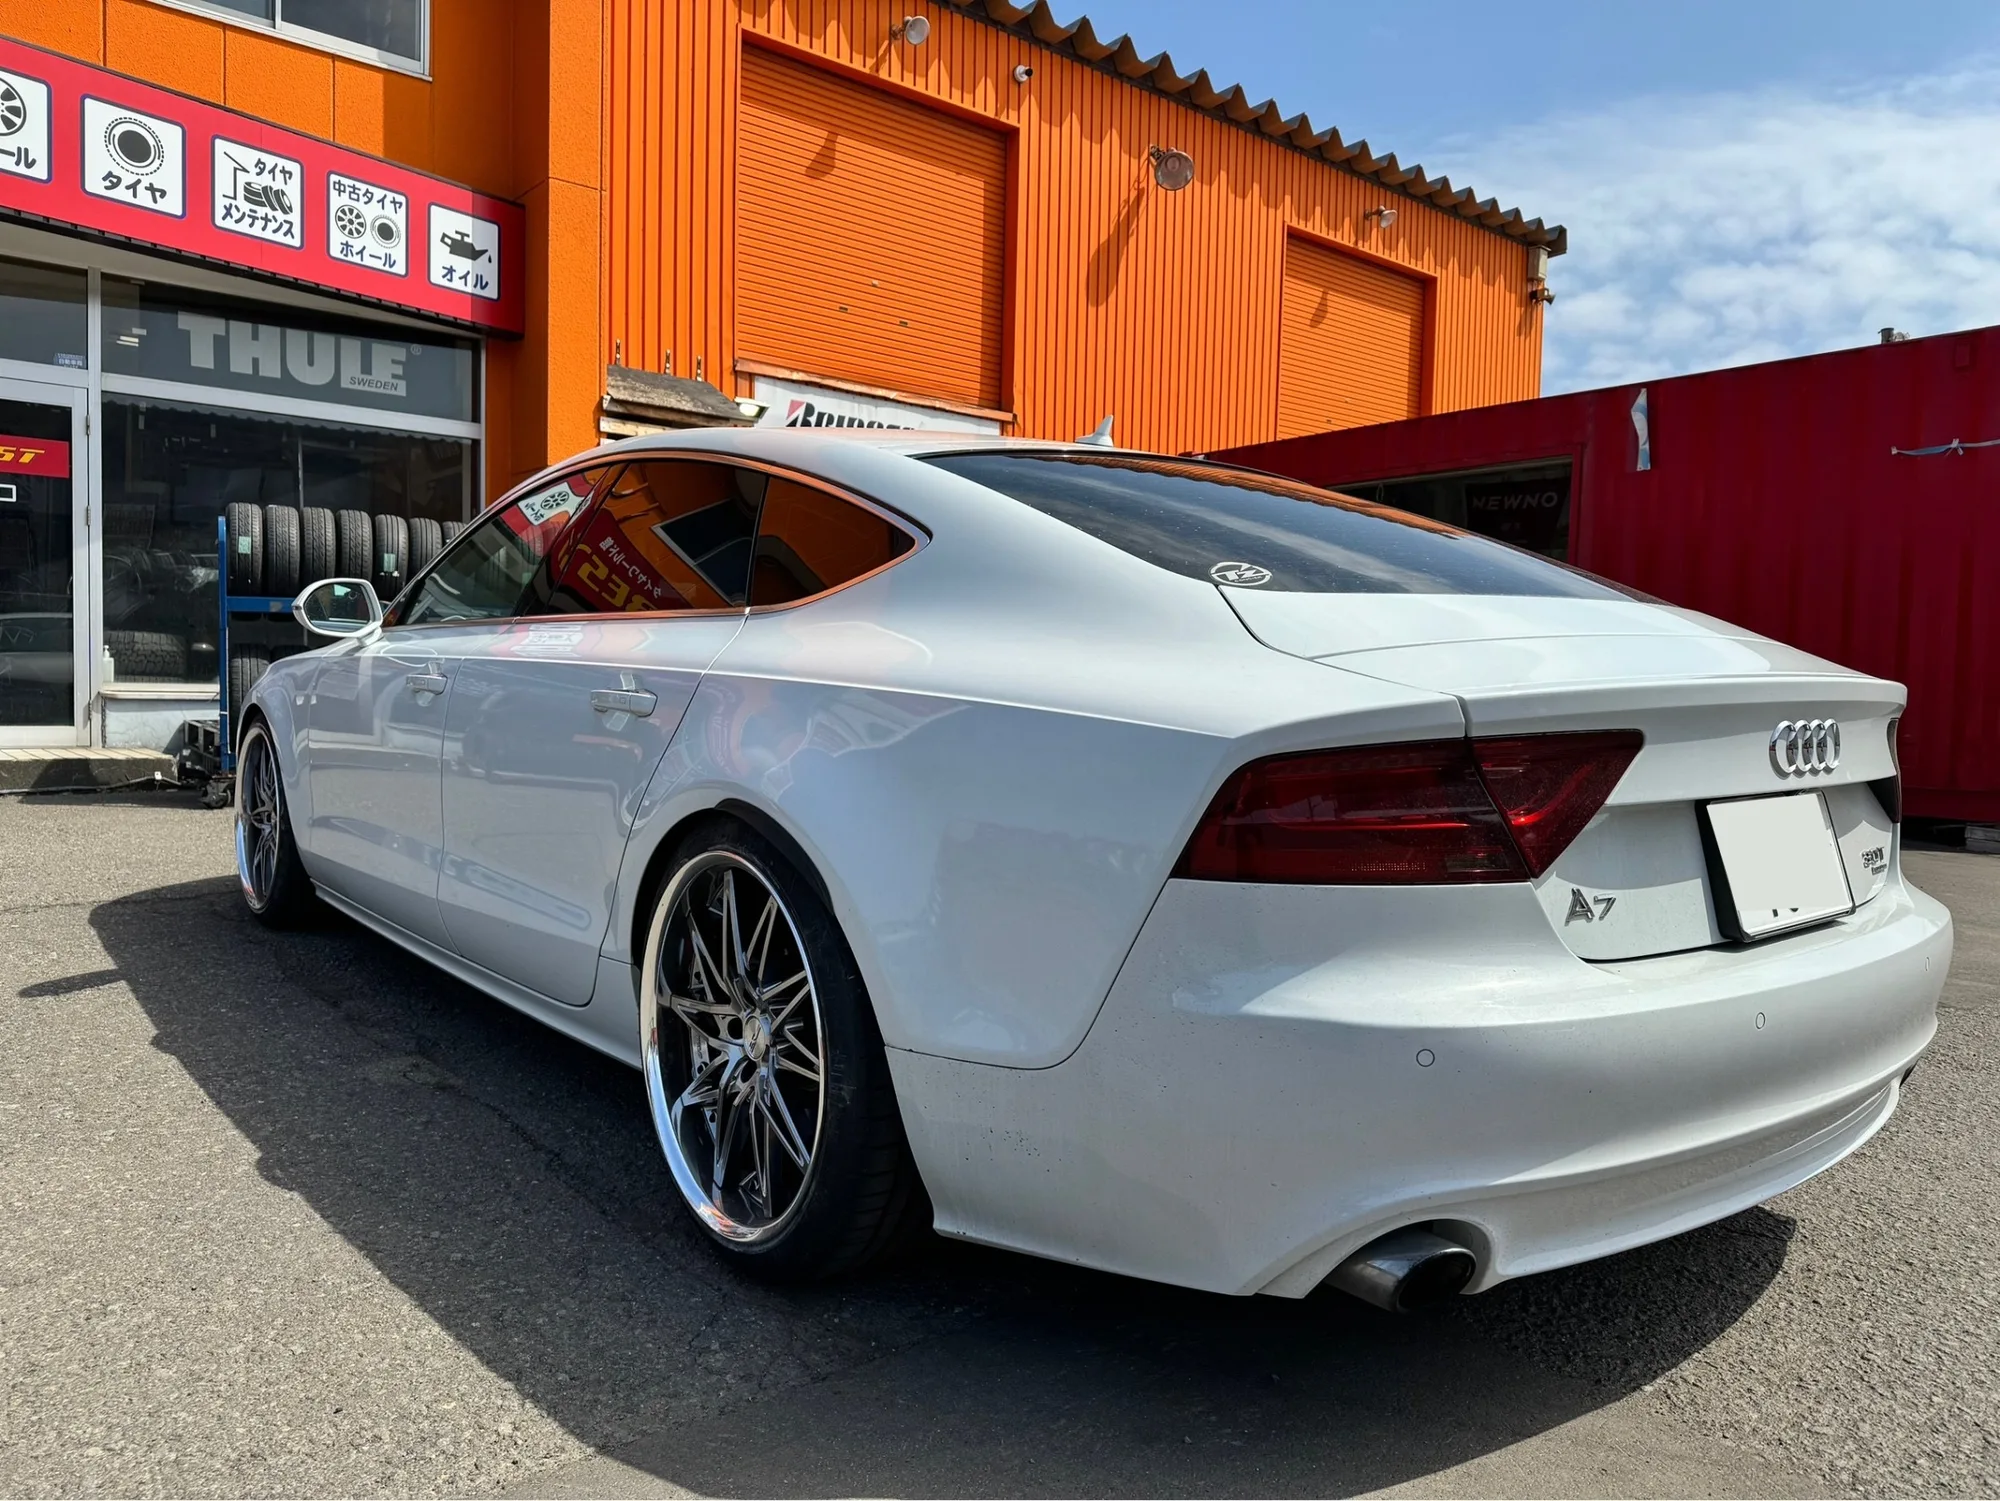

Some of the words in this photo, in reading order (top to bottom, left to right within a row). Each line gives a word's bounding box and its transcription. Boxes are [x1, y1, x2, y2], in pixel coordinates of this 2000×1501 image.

[101, 170, 167, 204] タイヤ
[254, 158, 293, 185] タイヤ
[332, 179, 403, 214] 中古タイヤ
[221, 203, 294, 239] メンテナンス
[340, 240, 396, 268] ホイール
[441, 265, 489, 290] オイル
[178, 311, 407, 397] THULE
[348, 375, 399, 392] SWEDEN
[1565, 888, 1617, 924] A7
